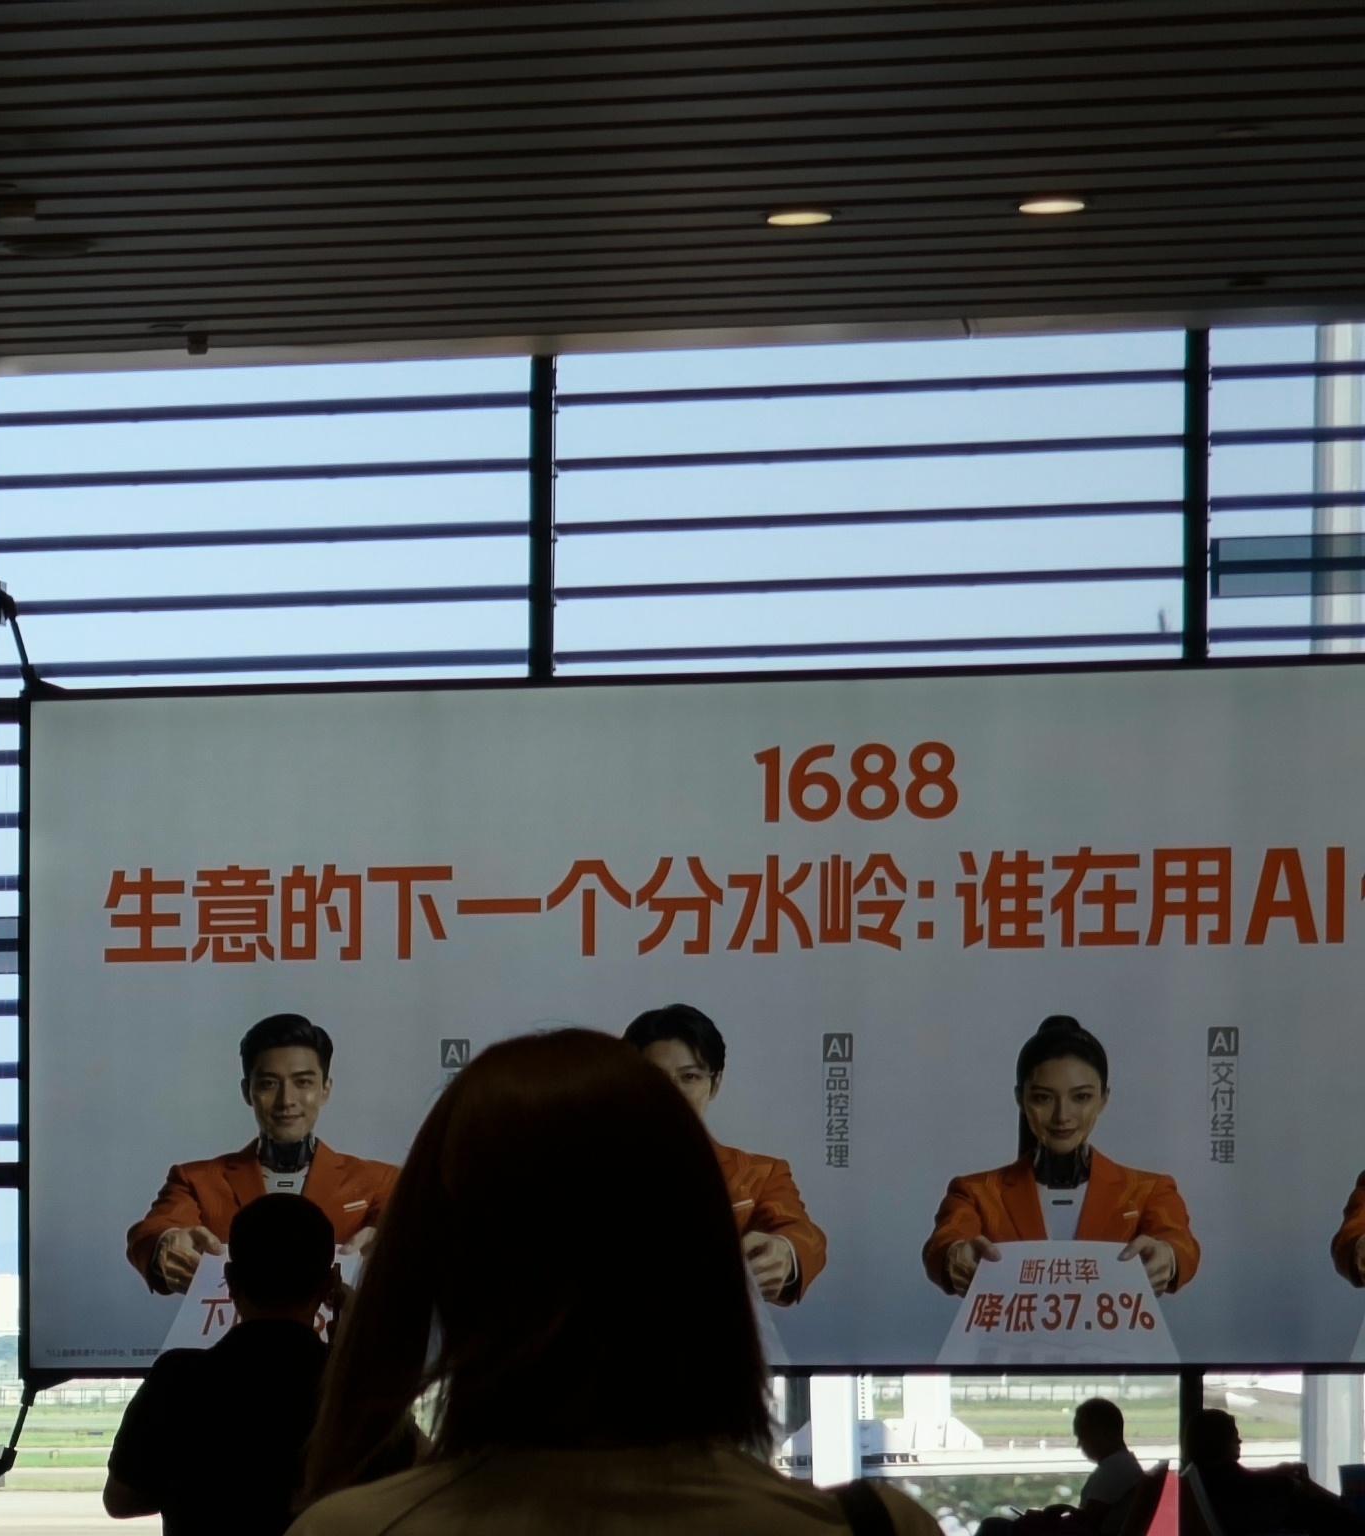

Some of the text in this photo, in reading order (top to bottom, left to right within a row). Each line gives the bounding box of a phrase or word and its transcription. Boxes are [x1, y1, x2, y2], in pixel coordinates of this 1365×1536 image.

[754, 742, 959, 822] 1688
[103, 846, 1365, 964] 生意的下一个分水岭：谁在用AI
[444, 1042, 468, 1065] AI
[826, 1037, 849, 1058] AI
[1211, 1031, 1235, 1053] AI
[825, 1066, 849, 1168] 品控经理
[1210, 1061, 1235, 1164] 交付经理
[1019, 1258, 1100, 1284] 断供率
[964, 1292, 1155, 1333] 降低37.8%
